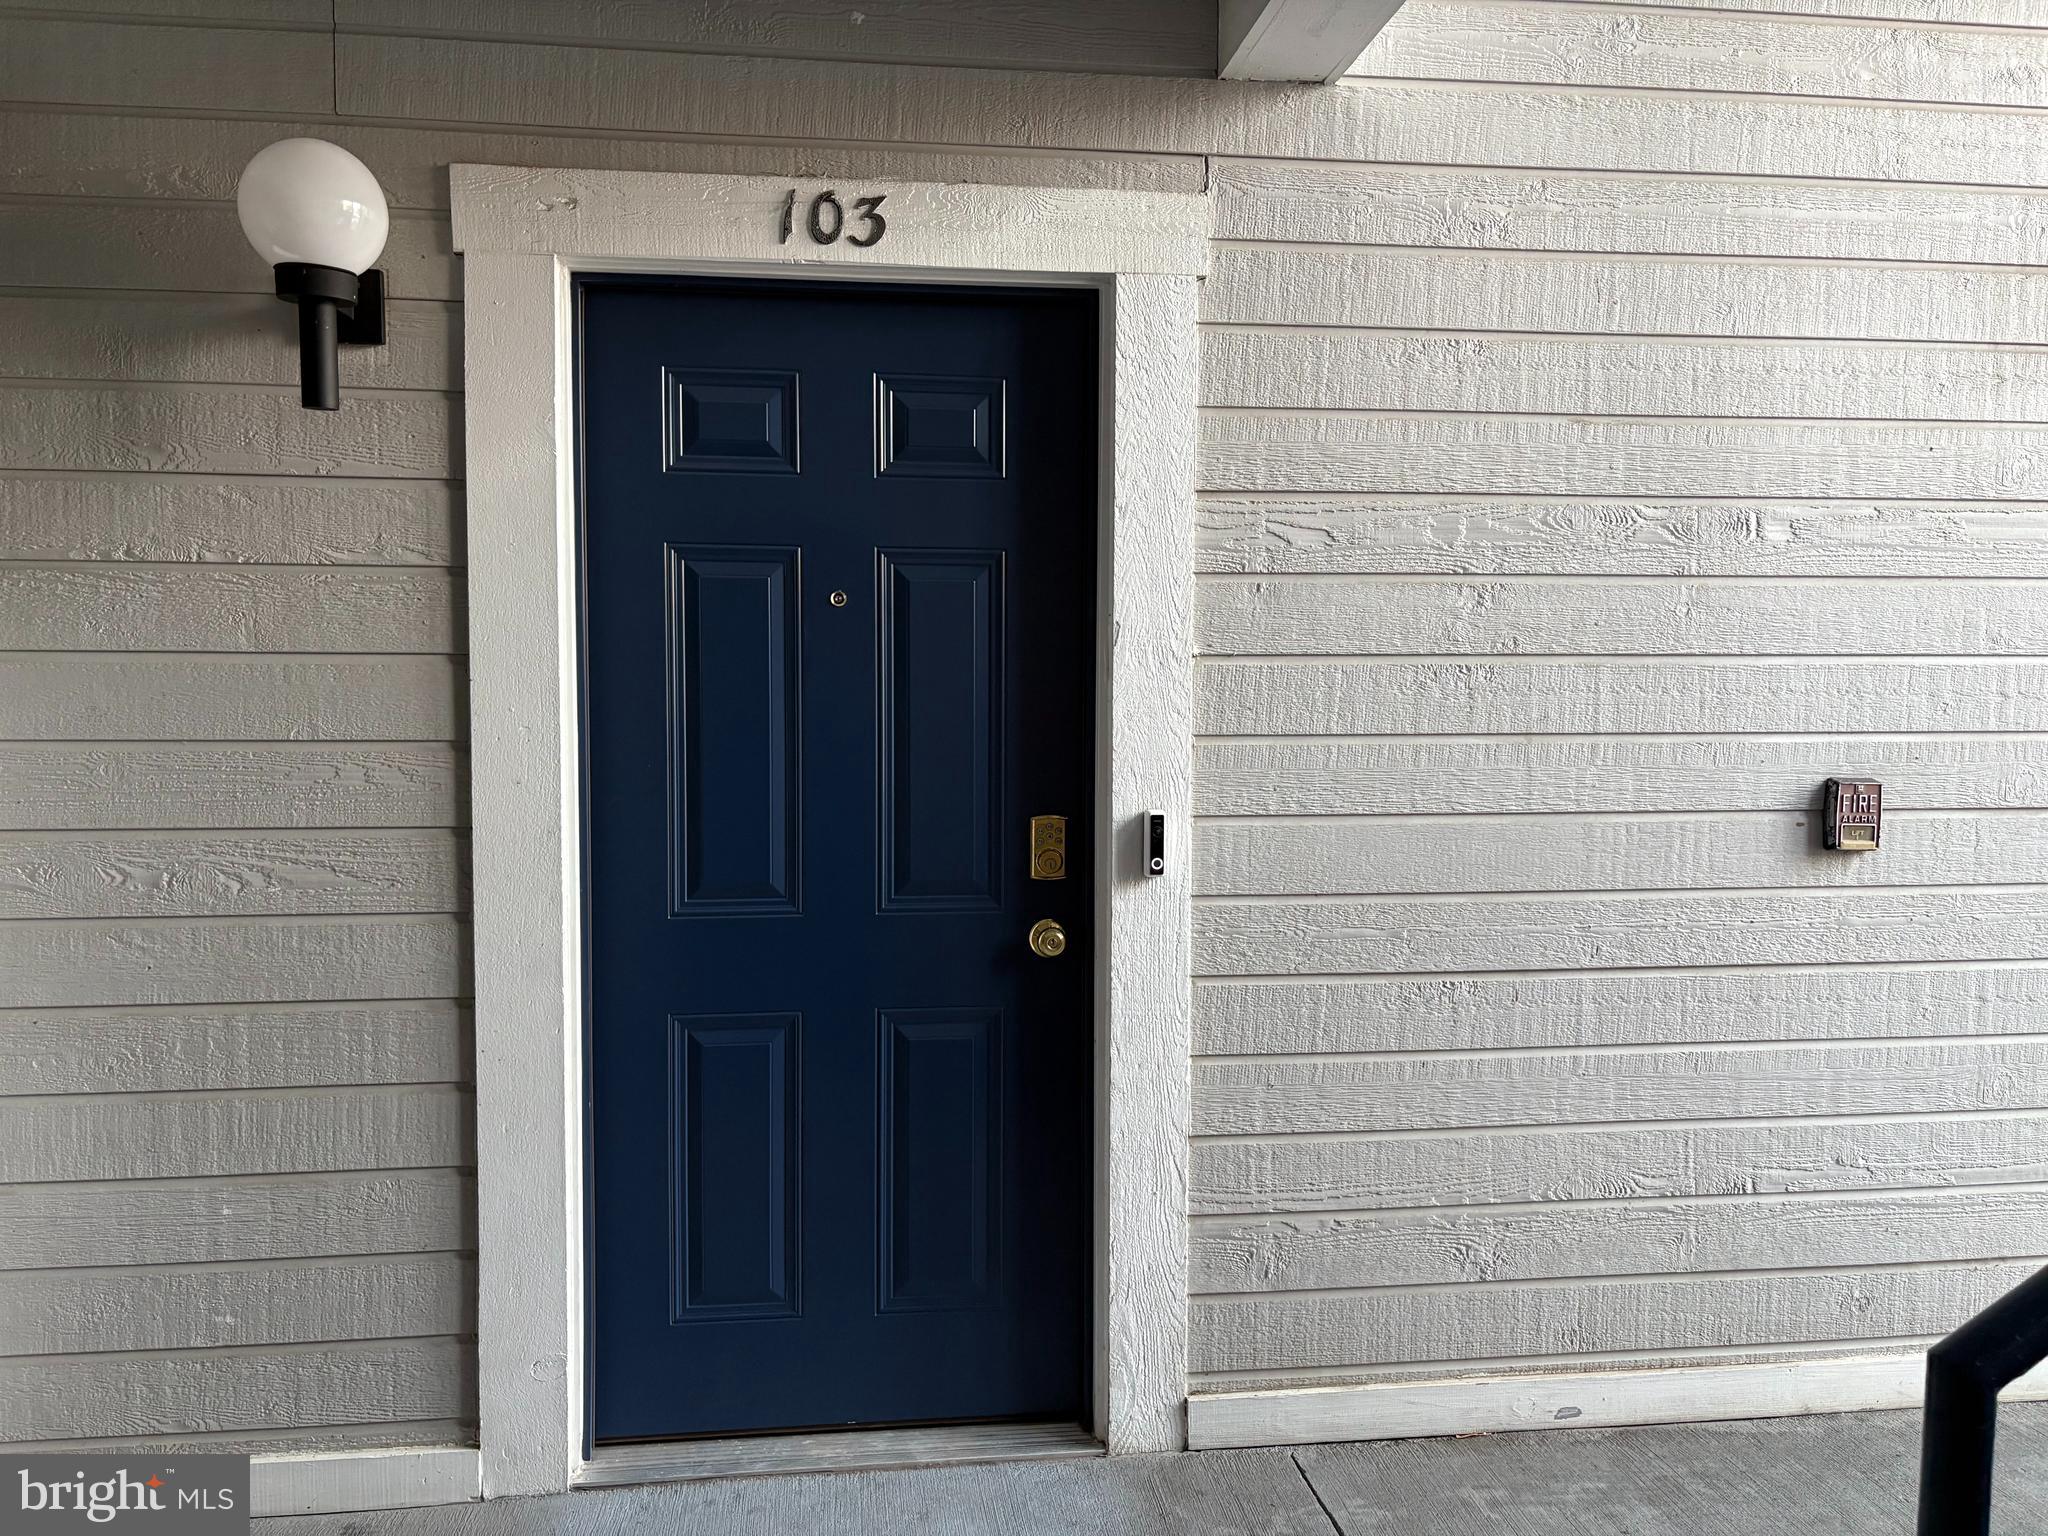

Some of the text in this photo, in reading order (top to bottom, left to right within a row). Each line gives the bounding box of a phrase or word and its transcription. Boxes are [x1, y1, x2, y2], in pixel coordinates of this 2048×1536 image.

[779, 188, 887, 248] 103
[1842, 794, 1877, 812] FIRE
[1842, 815, 1876, 823] ALARM
